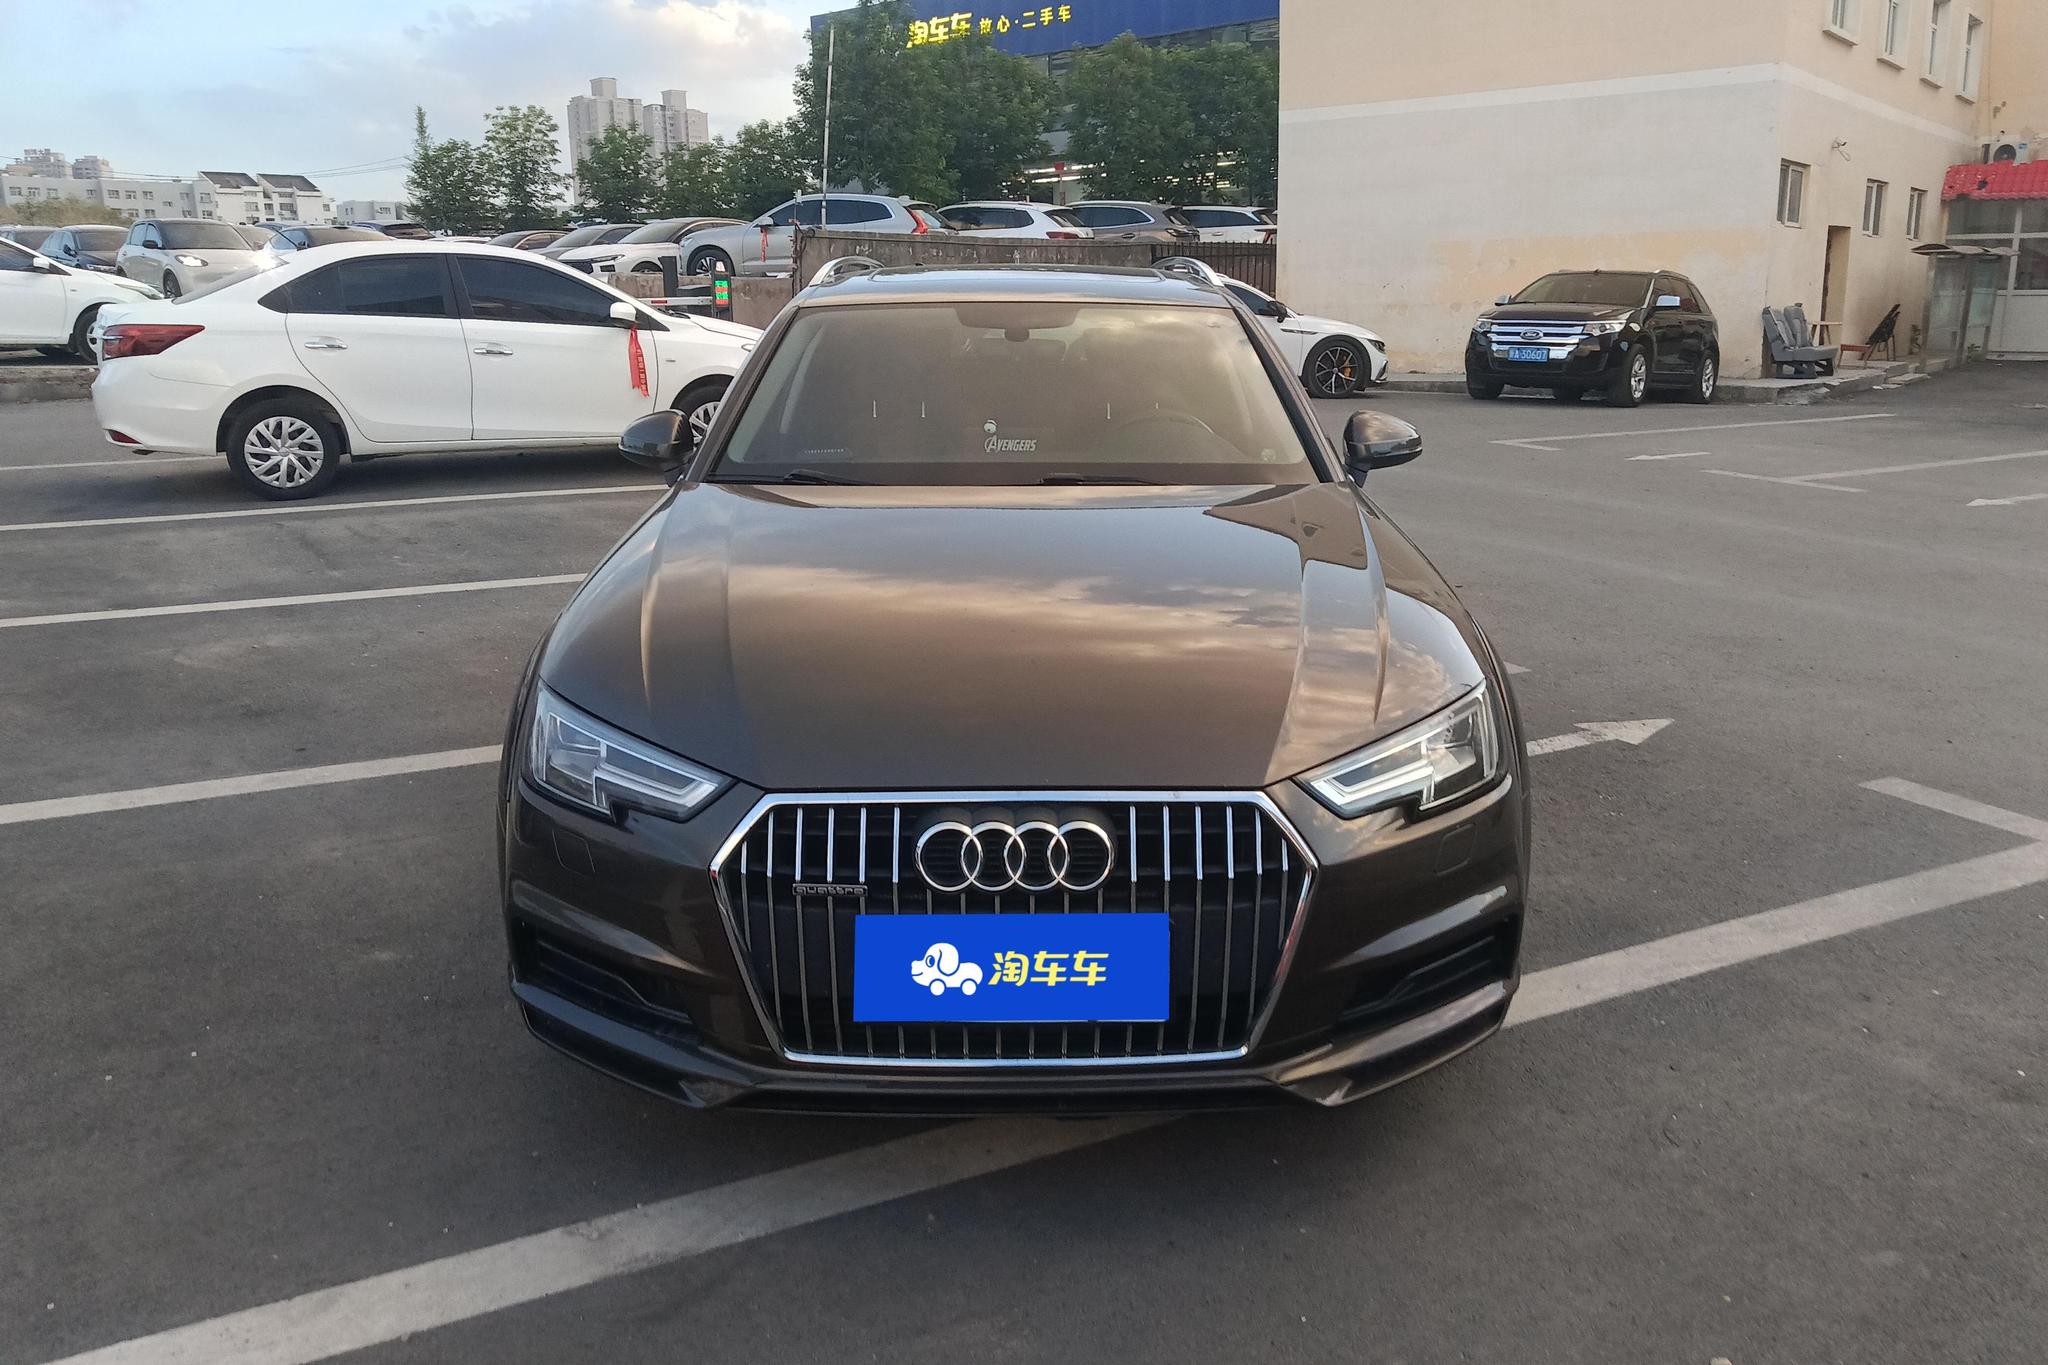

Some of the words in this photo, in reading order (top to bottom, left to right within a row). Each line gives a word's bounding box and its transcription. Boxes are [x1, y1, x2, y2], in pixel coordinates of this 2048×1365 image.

[906, 12, 973, 48] 淘车车
[984, 435, 1037, 452] AVENGERS
[796, 886, 864, 896] quattro
